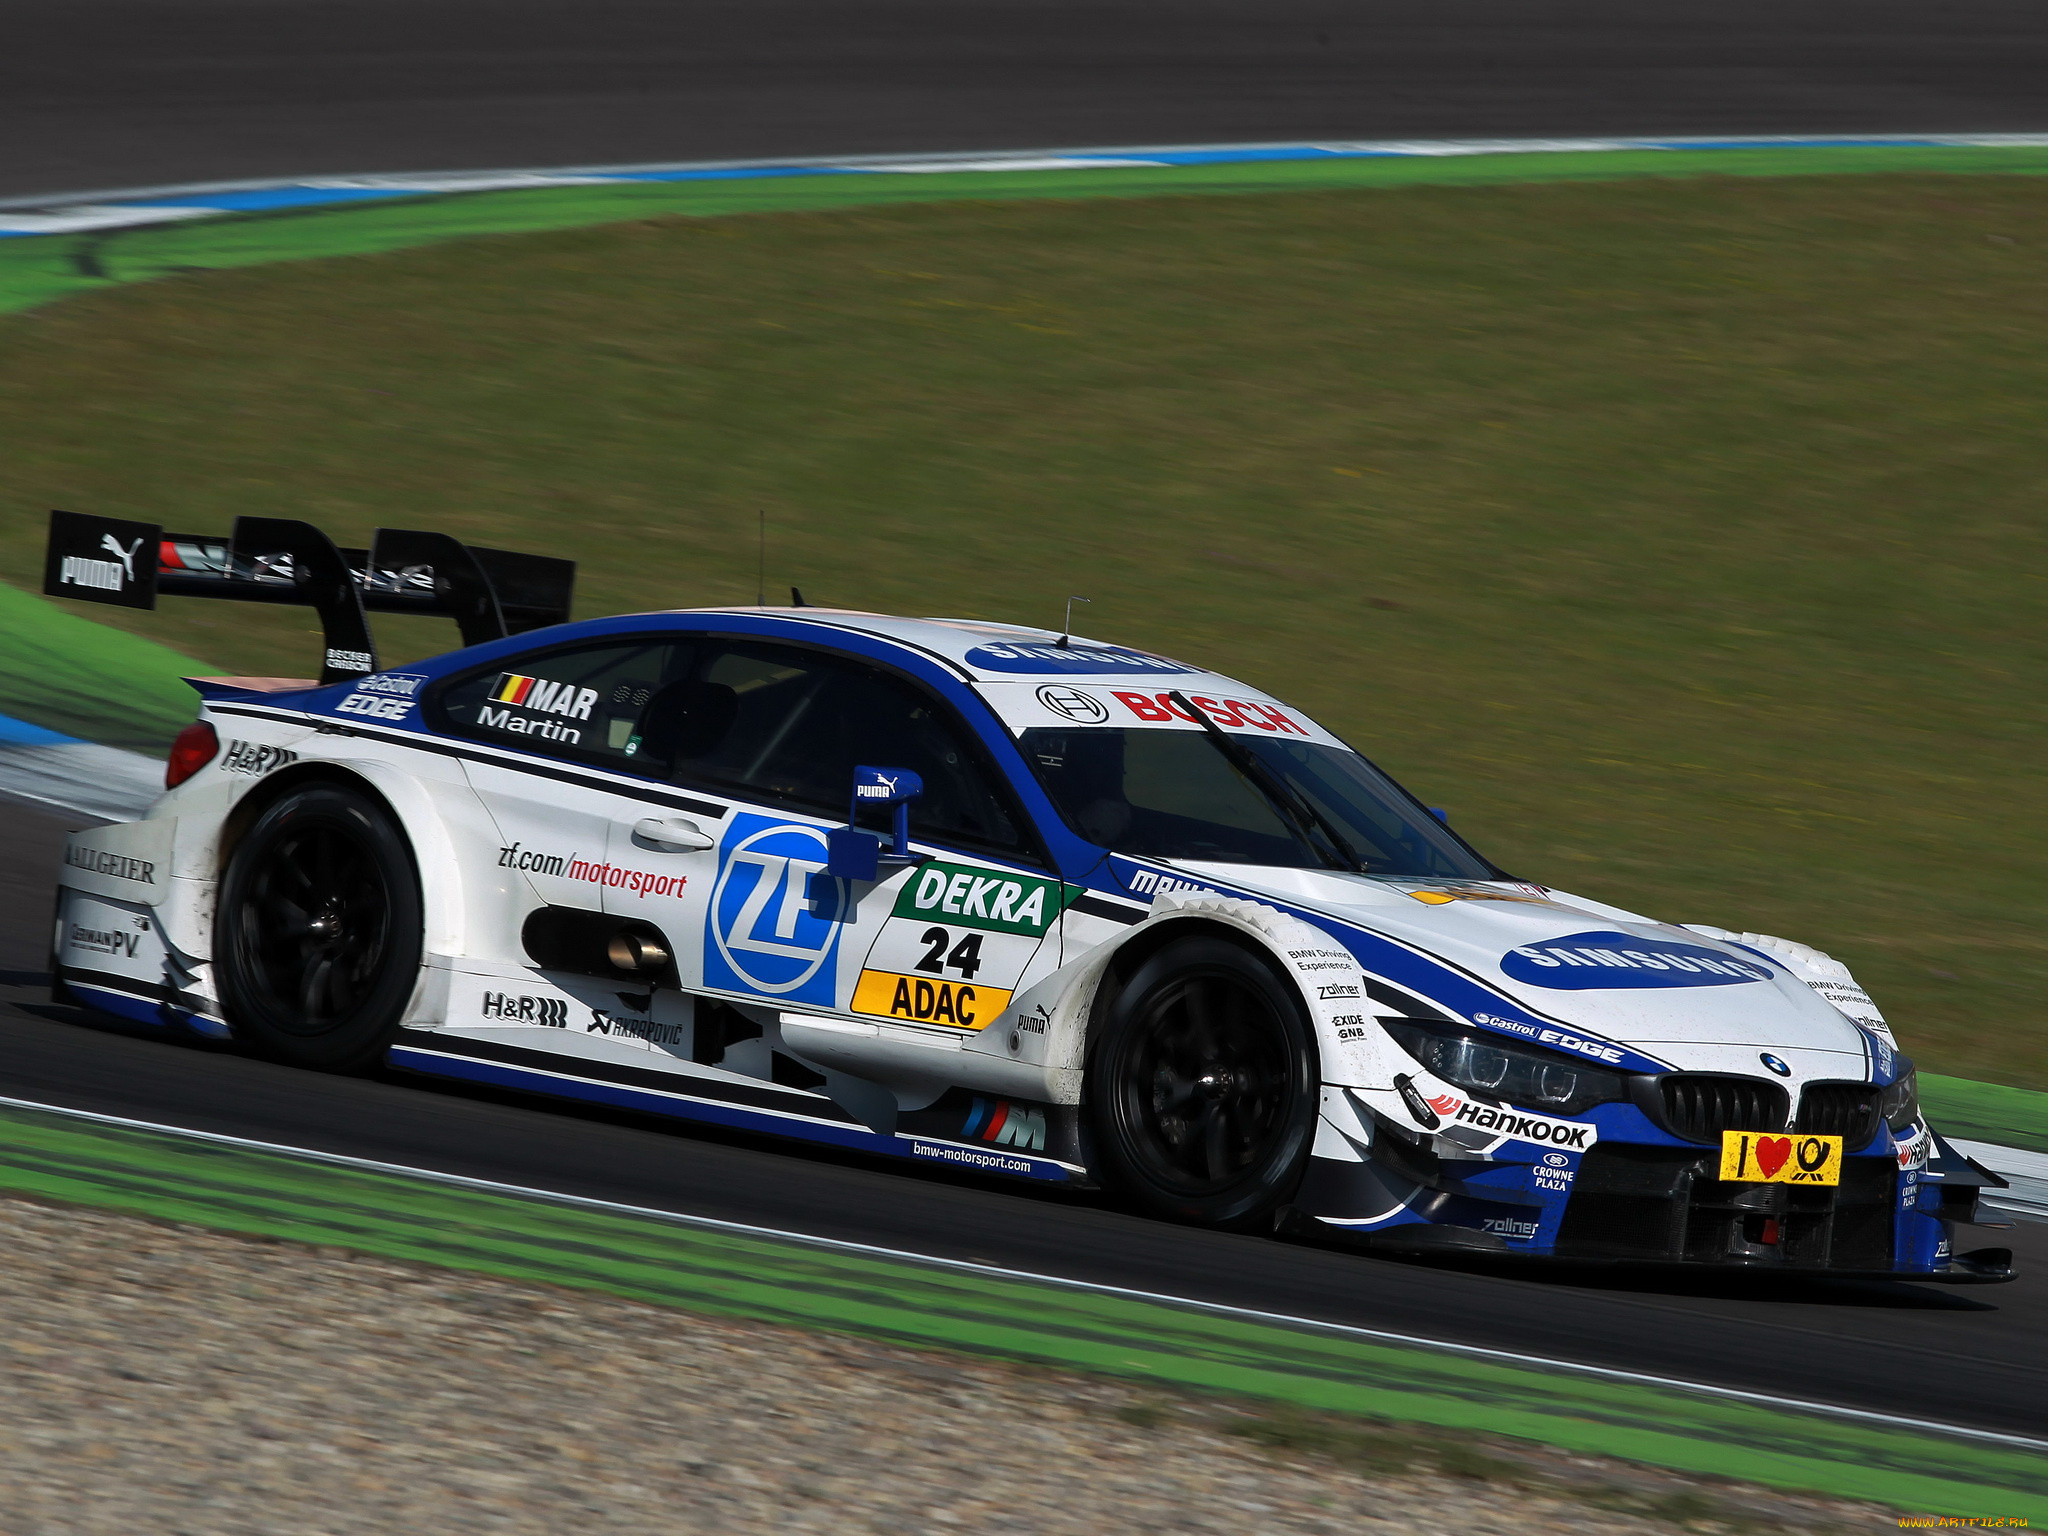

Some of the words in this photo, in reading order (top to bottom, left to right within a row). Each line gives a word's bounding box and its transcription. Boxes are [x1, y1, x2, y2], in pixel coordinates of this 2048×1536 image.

[60, 555, 123, 592] PUMA
[334, 693, 417, 721] EDGE
[524, 678, 599, 722] MAR
[1109, 690, 1312, 737] BOSCH
[476, 705, 582, 745] Martin
[857, 784, 890, 798] PUMA
[498, 841, 688, 899] zf.com/motorsport
[724, 849, 830, 962] ZF
[915, 868, 1046, 927] DEKRA
[913, 926, 982, 980] 24
[1287, 949, 1317, 960] BMW
[1316, 949, 1353, 961] Driving
[1297, 962, 1353, 972] Experience
[1516, 947, 1764, 981] SAMSUNG
[890, 977, 976, 1027] ADAC
[1807, 981, 1835, 990] BMW
[483, 990, 538, 1024] H&R
[1018, 1014, 1046, 1034] PUMA
[1332, 1015, 1365, 1027] EXIDE
[1338, 1028, 1365, 1039] GNB
[1489, 1017, 1537, 1036] Castrol
[1538, 1029, 1626, 1064] EDGE
[912, 1141, 1031, 1173] bmw-motorsport.com
[1532, 1166, 1575, 1182] CROWNE
[1535, 1177, 1567, 1192] PLAZA
